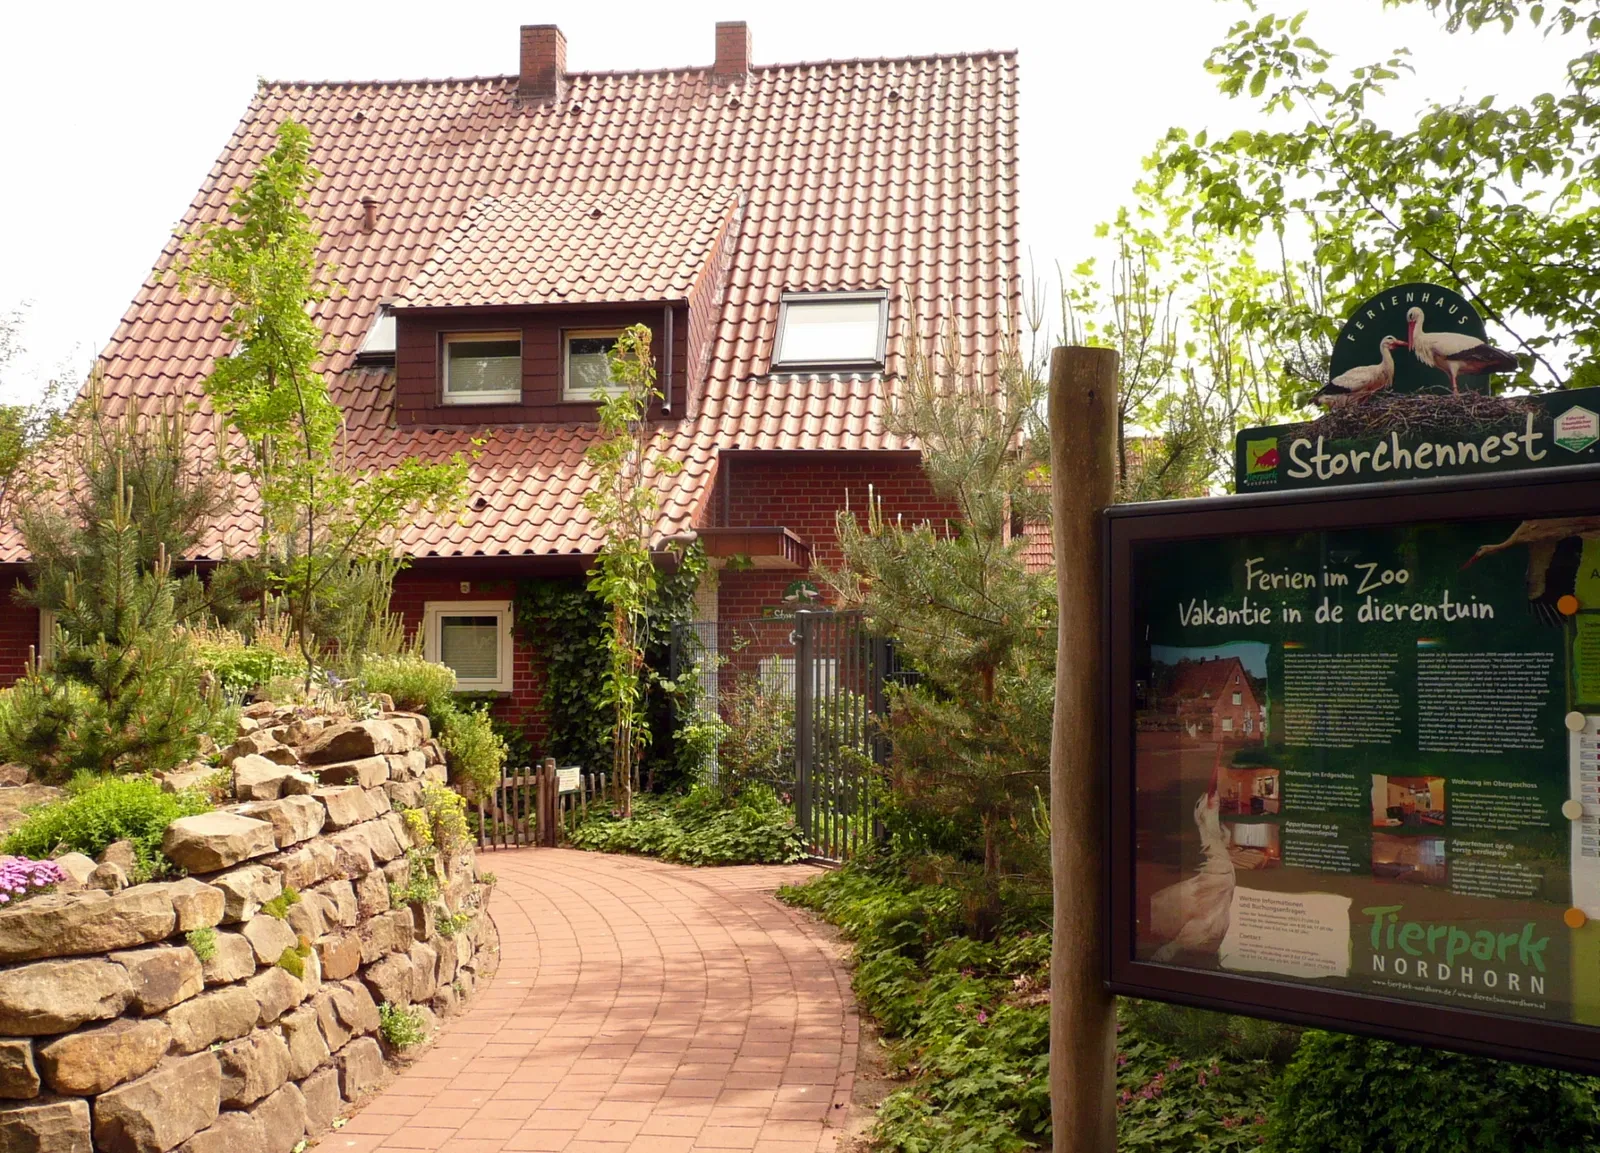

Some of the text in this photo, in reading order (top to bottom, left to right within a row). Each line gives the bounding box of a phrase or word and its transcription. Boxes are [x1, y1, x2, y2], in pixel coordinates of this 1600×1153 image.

[1346, 292, 1470, 343] FERIENHAUS
[1287, 412, 1547, 480] Storchennest
[1245, 557, 1410, 595] Ferien im Zoo
[1178, 590, 1495, 627] Vakantie in de dierentuin
[1451, 778, 1482, 787] Wohnung
[1493, 780, 1538, 789] Obergeschoss
[1361, 905, 1550, 972] Tierpark
[1373, 954, 1545, 995] NORDHORN
